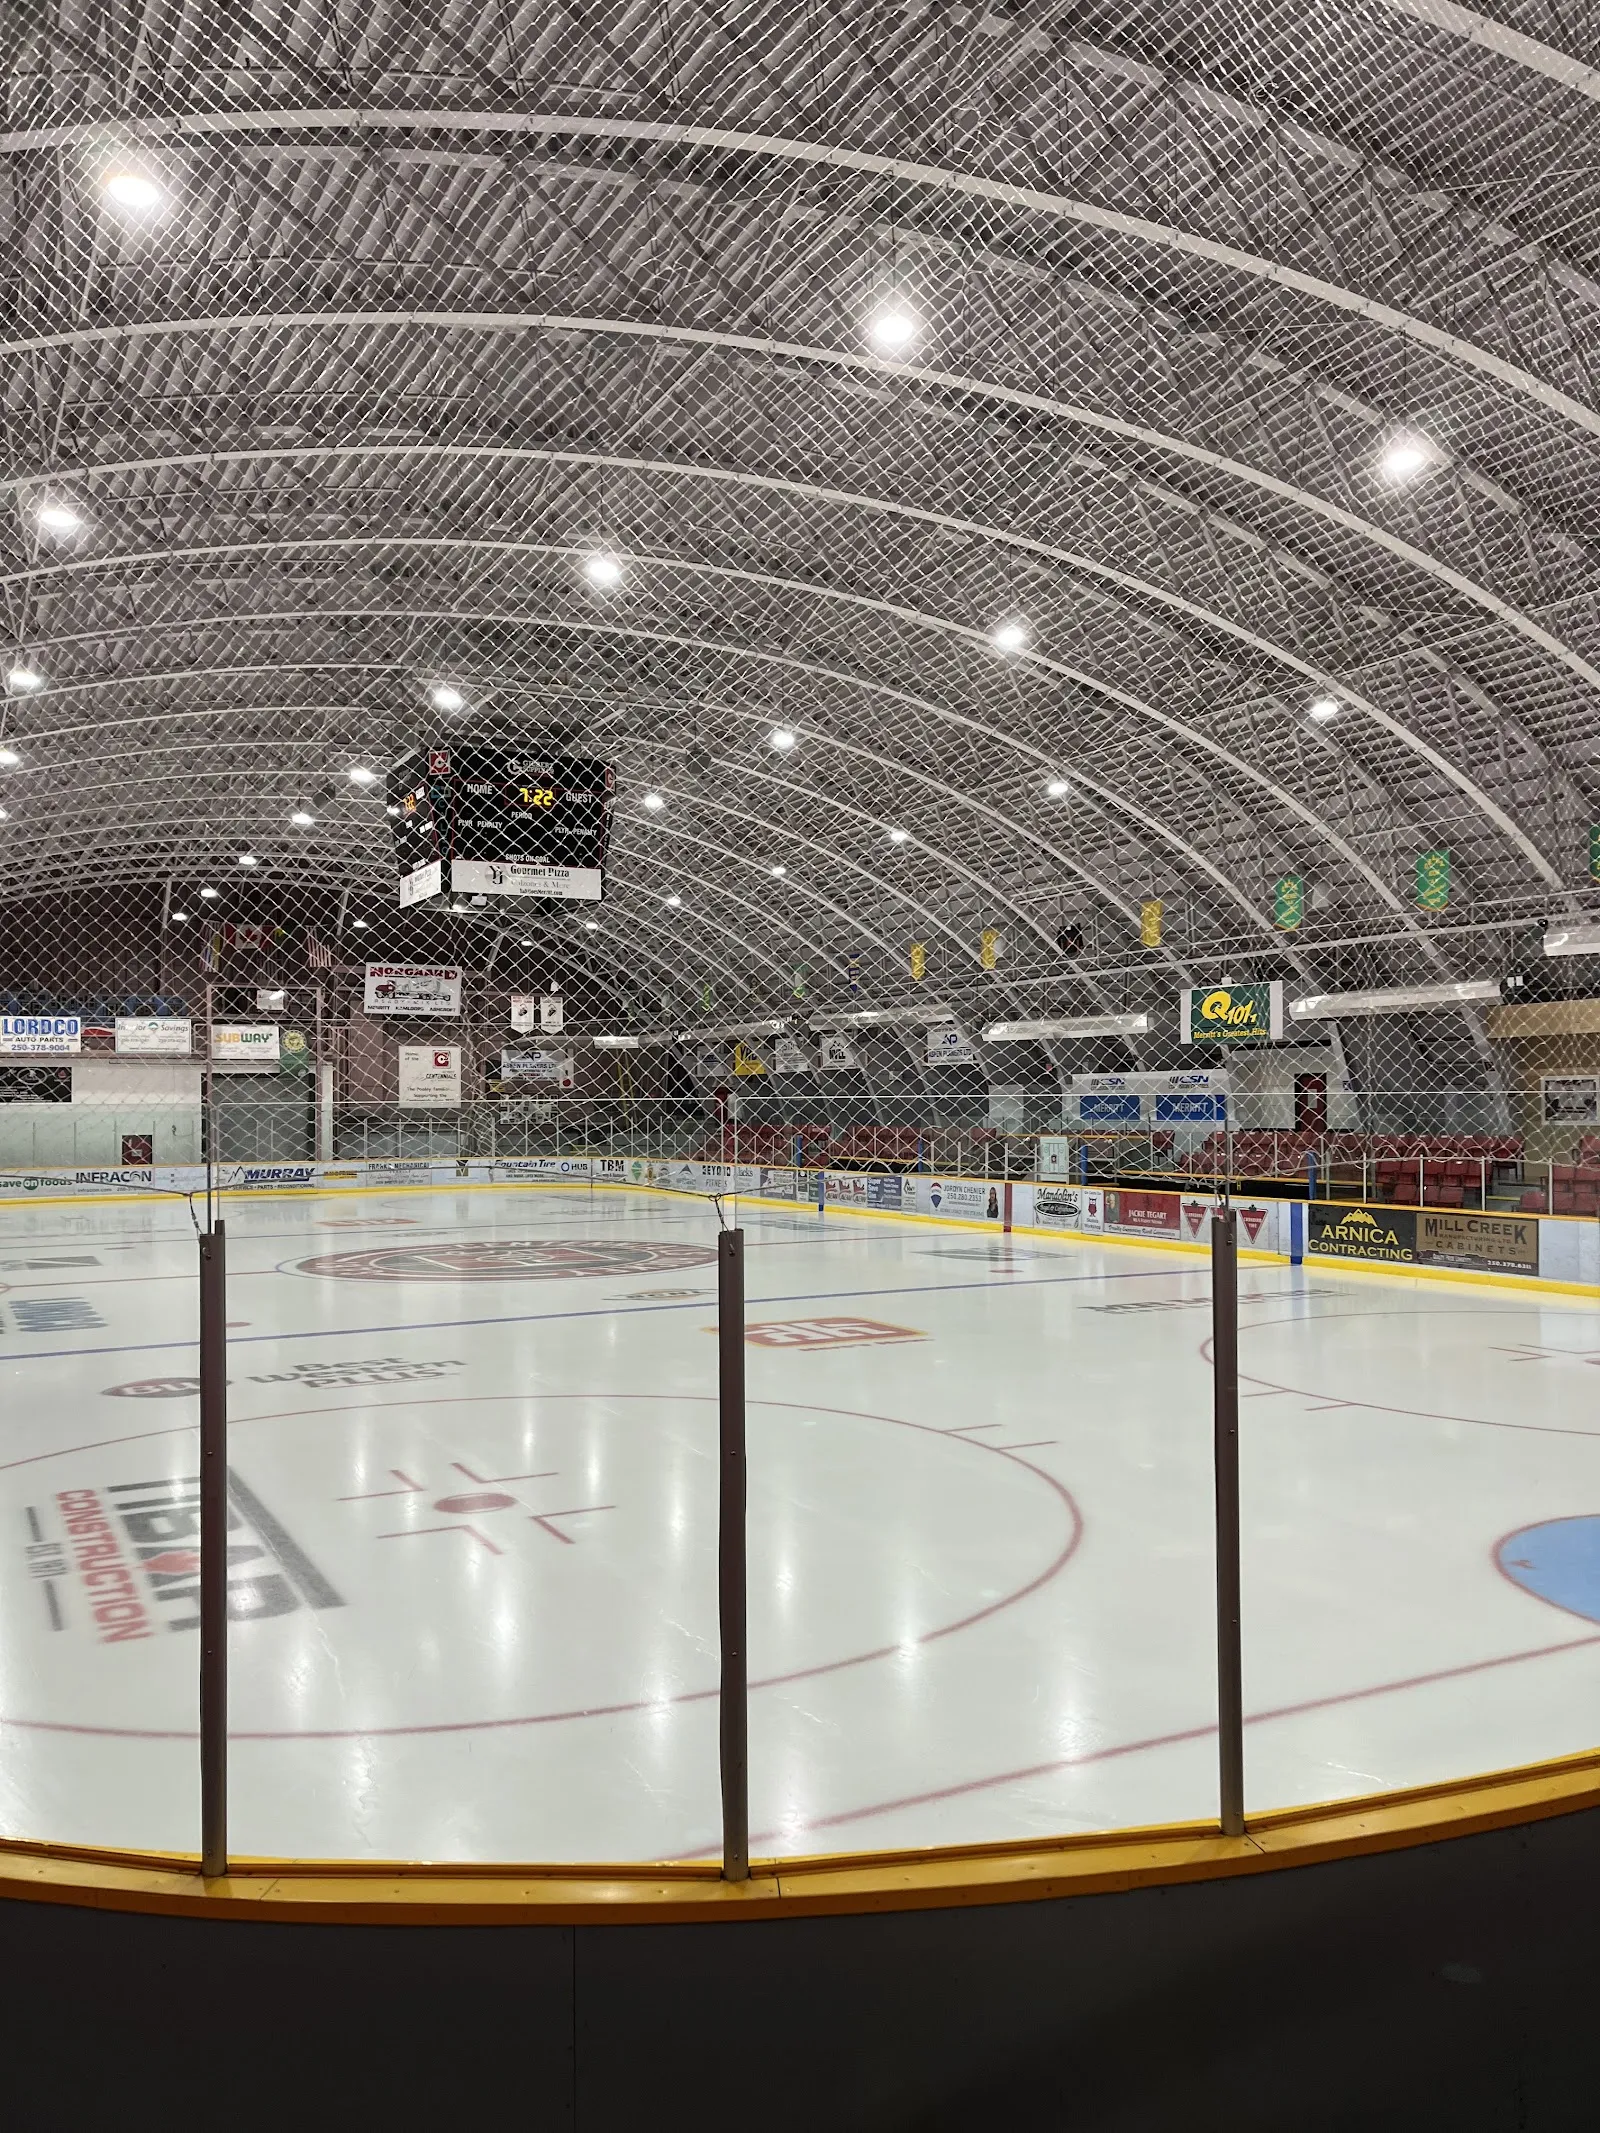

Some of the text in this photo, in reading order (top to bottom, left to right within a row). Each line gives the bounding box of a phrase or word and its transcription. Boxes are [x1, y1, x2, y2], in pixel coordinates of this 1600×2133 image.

[466, 783, 493, 795] HOME
[519, 787, 554, 806] 7:22
[565, 791, 593, 804] GUEST
[511, 810, 533, 820] PERIOD
[477, 820, 503, 829] PENALTY
[510, 864, 546, 877] Gourmet
[3, 1018, 79, 1036] LORDCO
[160, 1024, 189, 1033] Savings
[215, 1032, 273, 1044] SUBWAY
[1093, 1103, 1124, 1113] MERRITT
[1172, 1102, 1209, 1113] MERRITT
[494, 1159, 556, 1168] Fountain Tire
[571, 1163, 588, 1171] HUB
[244, 1167, 316, 1180] MURRAY
[1128, 1209, 1168, 1220] JACKIE TEGART
[1320, 1224, 1400, 1246] ARNICA
[1424, 1217, 1528, 1245] MILL CREEK
[1439, 1233, 1497, 1243] MANUFACTURING
[1308, 1239, 1413, 1261] CONTRACTING
[1435, 1240, 1517, 1255] CABINETS
[290, 1357, 413, 1372] Best
[300, 1370, 447, 1389] PLUS
[56, 1489, 156, 1644] CONSTRUCTION
